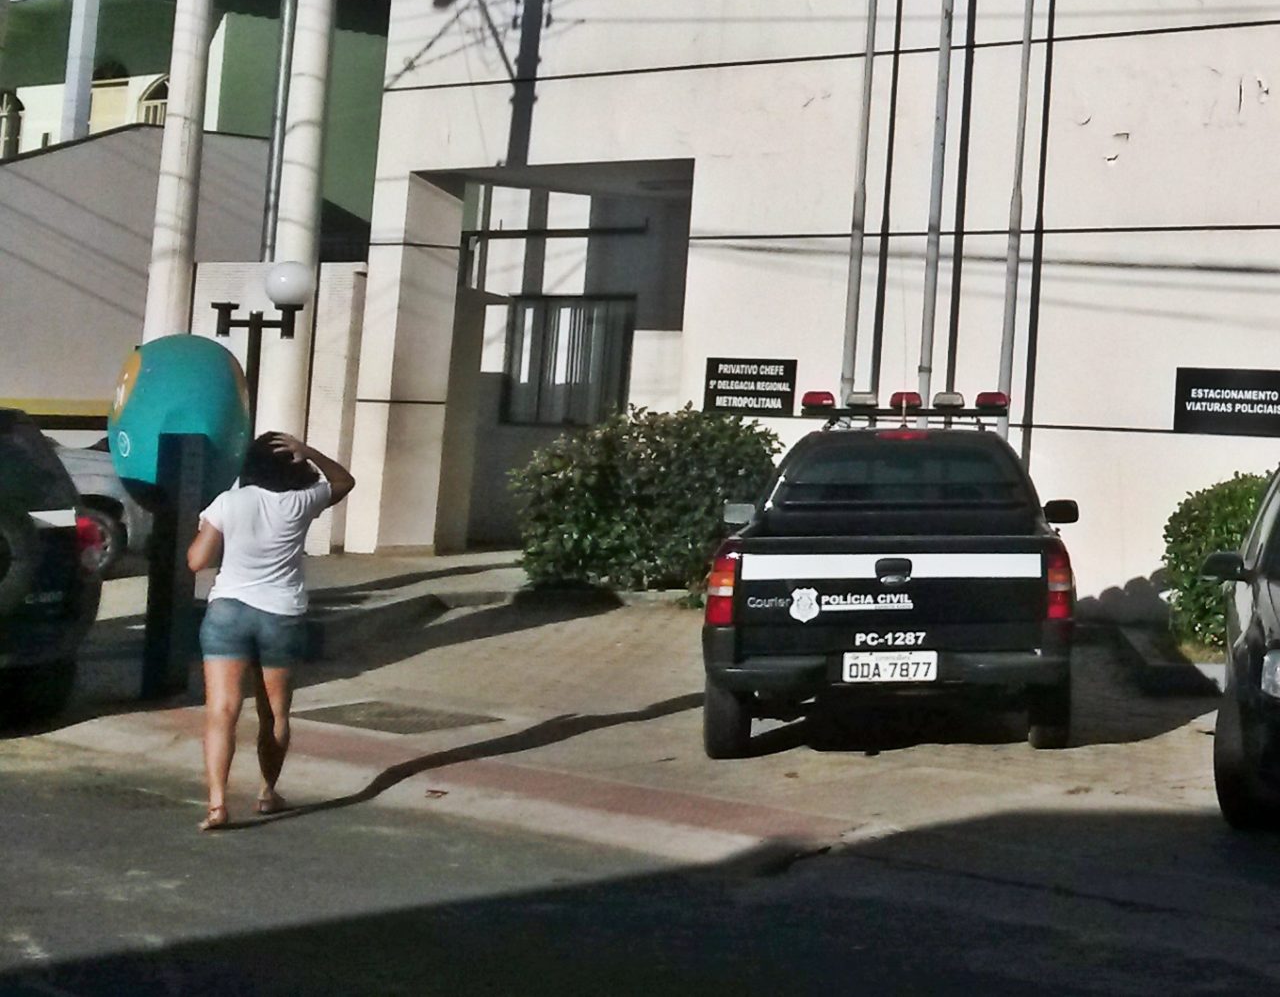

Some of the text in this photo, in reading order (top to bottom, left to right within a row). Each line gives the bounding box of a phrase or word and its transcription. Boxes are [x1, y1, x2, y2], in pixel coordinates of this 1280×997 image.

[718, 363, 784, 376] PRIVATIVO CHEFE
[717, 380, 755, 390] DELEGACIA
[756, 382, 791, 391] REGIONAL
[1191, 388, 1279, 401] ESTACIONAMENTO
[715, 396, 782, 409] METROPOLITANA
[1185, 401, 1232, 412] VIATURAS
[747, 596, 791, 608] Courier
[821, 593, 912, 605] POLÍCIA CIVIL
[855, 632, 926, 646] PC-1287
